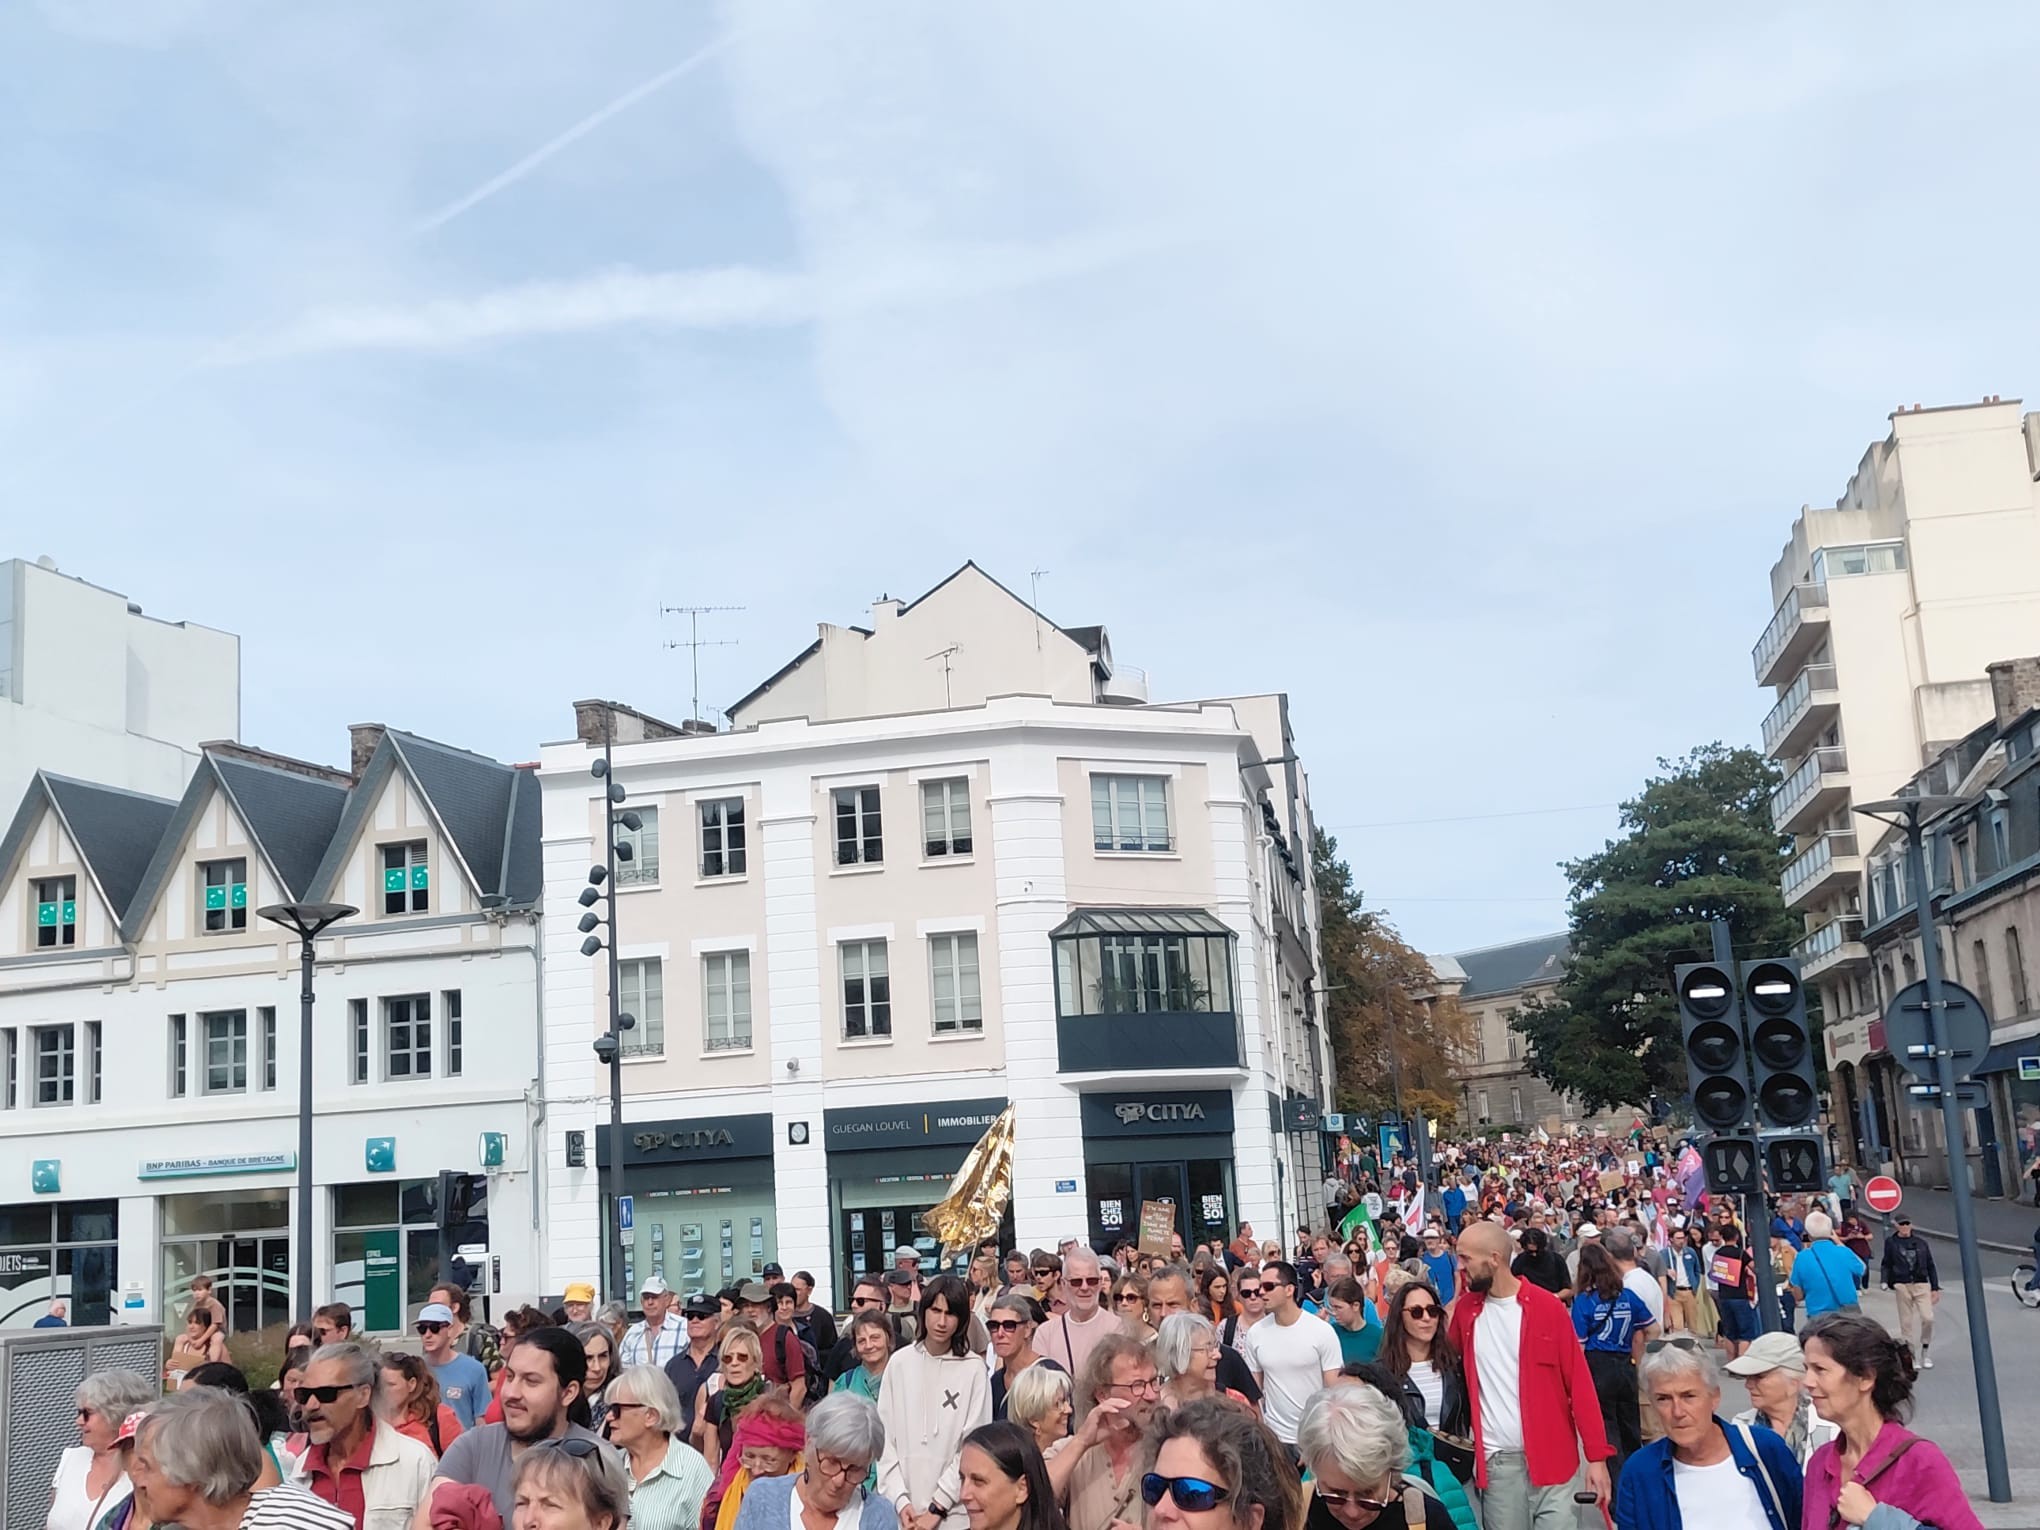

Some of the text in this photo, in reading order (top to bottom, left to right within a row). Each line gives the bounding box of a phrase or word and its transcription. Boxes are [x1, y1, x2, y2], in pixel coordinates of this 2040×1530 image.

[1146, 1103, 1205, 1121] CITYA
[832, 1114, 997, 1134] GUEGAN LOUVEL IMMOBILIER
[671, 1128, 735, 1148] CITYA
[146, 1162, 164, 1170] BNP
[165, 1159, 201, 1169] PARIBAS
[208, 1159, 236, 1167] BANQUE
[247, 1155, 284, 1164] BRETAGNE
[1100, 1199, 1121, 1209] BIEN
[1202, 1194, 1222, 1203] BIEN
[1101, 1214, 1123, 1225] SOI
[1203, 1208, 1224, 1220] SOI
